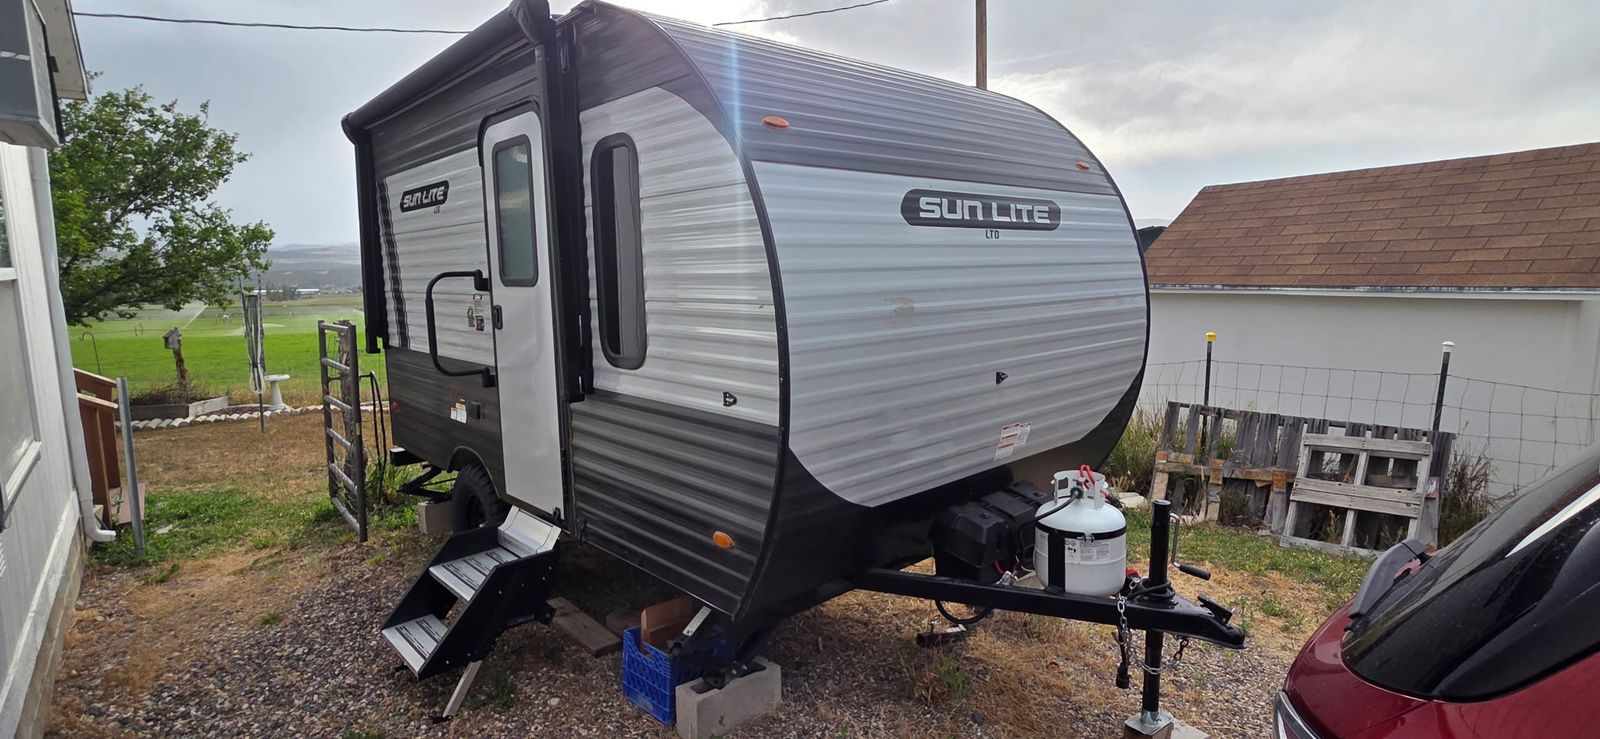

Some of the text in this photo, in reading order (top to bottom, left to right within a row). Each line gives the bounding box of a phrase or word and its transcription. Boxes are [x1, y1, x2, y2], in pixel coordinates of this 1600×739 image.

[403, 186, 445, 208] SUN LITE
[919, 196, 1052, 224] SUN LITE
[985, 229, 1000, 240] LTD
